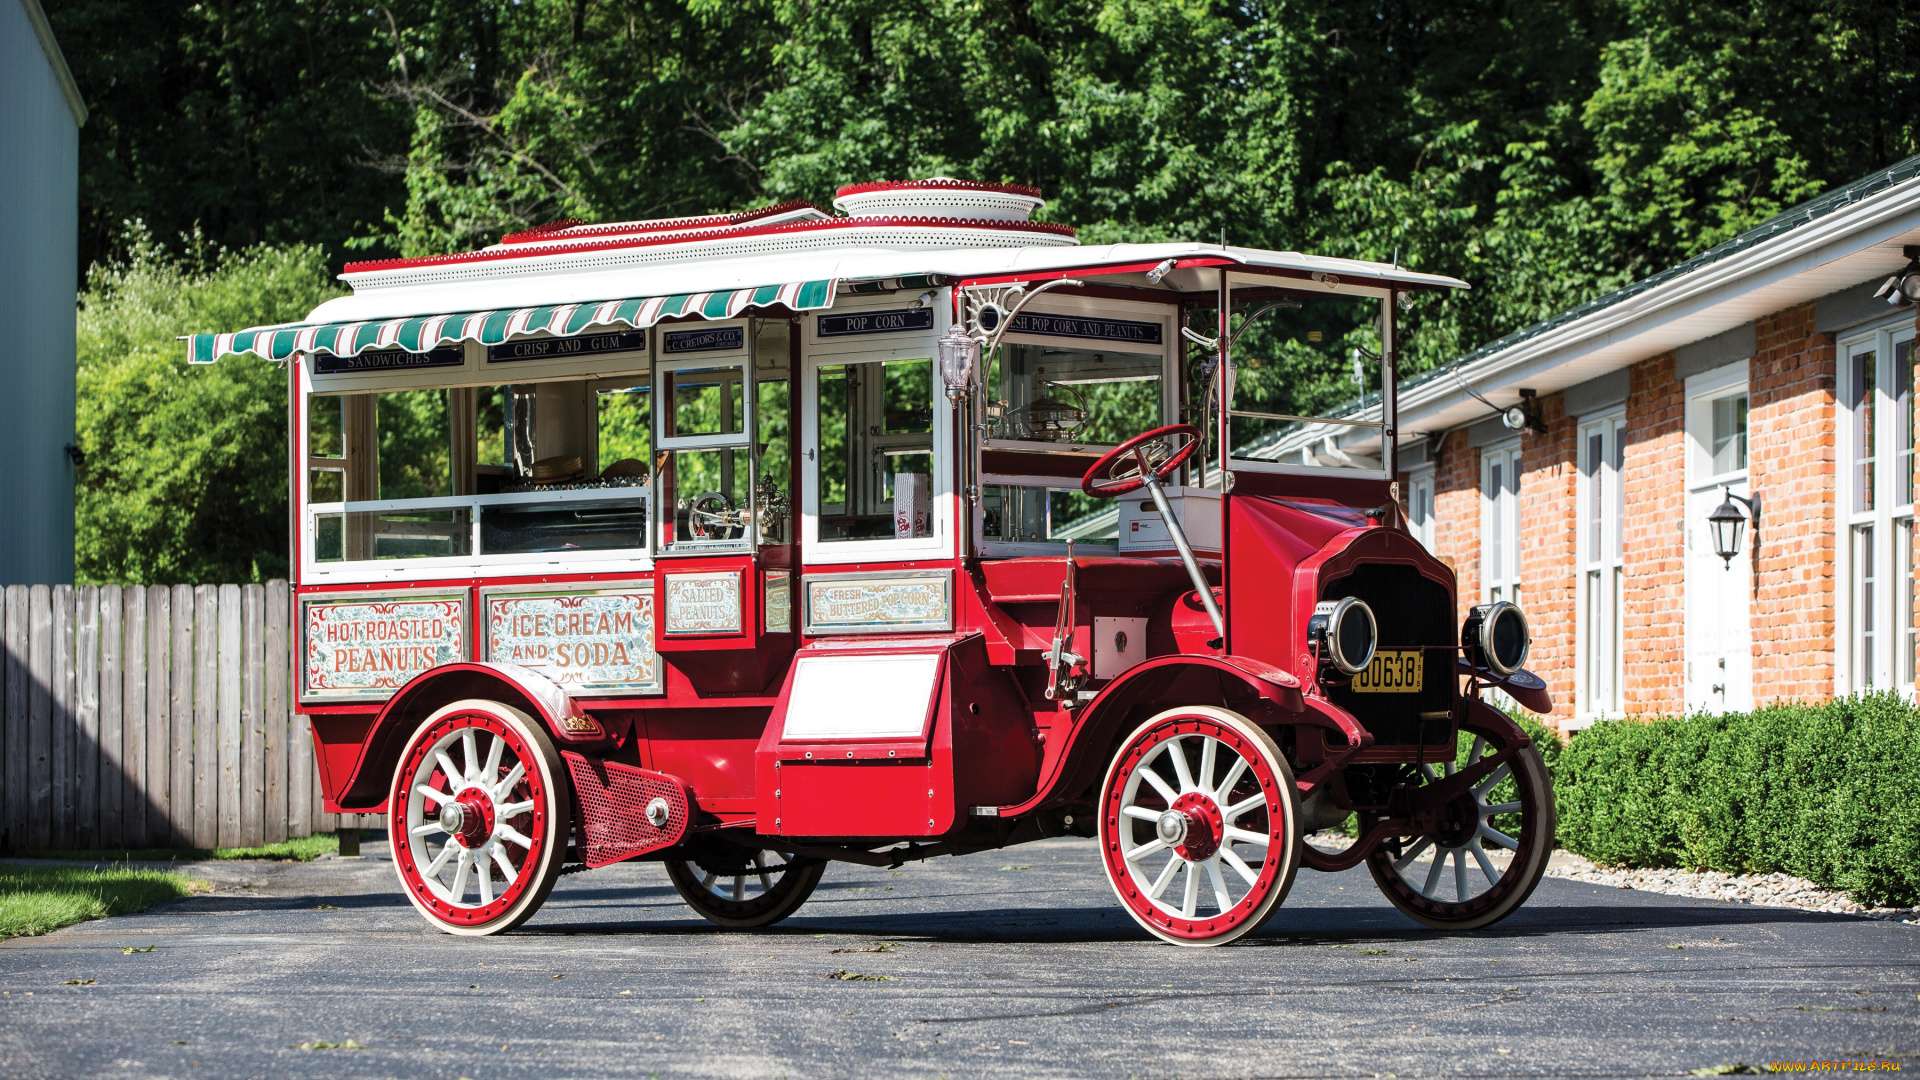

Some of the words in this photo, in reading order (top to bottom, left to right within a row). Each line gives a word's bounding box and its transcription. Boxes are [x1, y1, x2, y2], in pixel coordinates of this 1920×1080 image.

[846, 317, 868, 331] POP
[875, 314, 905, 329] CORN
[1009, 316, 1028, 330] ESH
[1032, 317, 1050, 331] POP
[1053, 319, 1078, 334] CORN
[1082, 322, 1101, 336] AND
[1104, 323, 1144, 339] PEANUTS
[514, 341, 550, 356] CRISP
[557, 339, 581, 353] AND
[591, 336, 620, 349] GUM
[680, 333, 715, 349] CRETORS
[716, 332, 723, 342] &
[347, 352, 431, 368] SANDWICHES
[682, 587, 724, 604] SALTED
[833, 589, 861, 600] FRESH
[679, 605, 726, 621] PEANUTS
[829, 599, 880, 617] BUTTERED
[327, 622, 361, 642] HOT
[366, 619, 443, 641] ROASTED
[512, 614, 546, 637] ICE
[554, 612, 632, 636] CREAM
[334, 646, 436, 673] PEANUTS
[512, 644, 548, 660] AND
[556, 642, 631, 668] SODA
